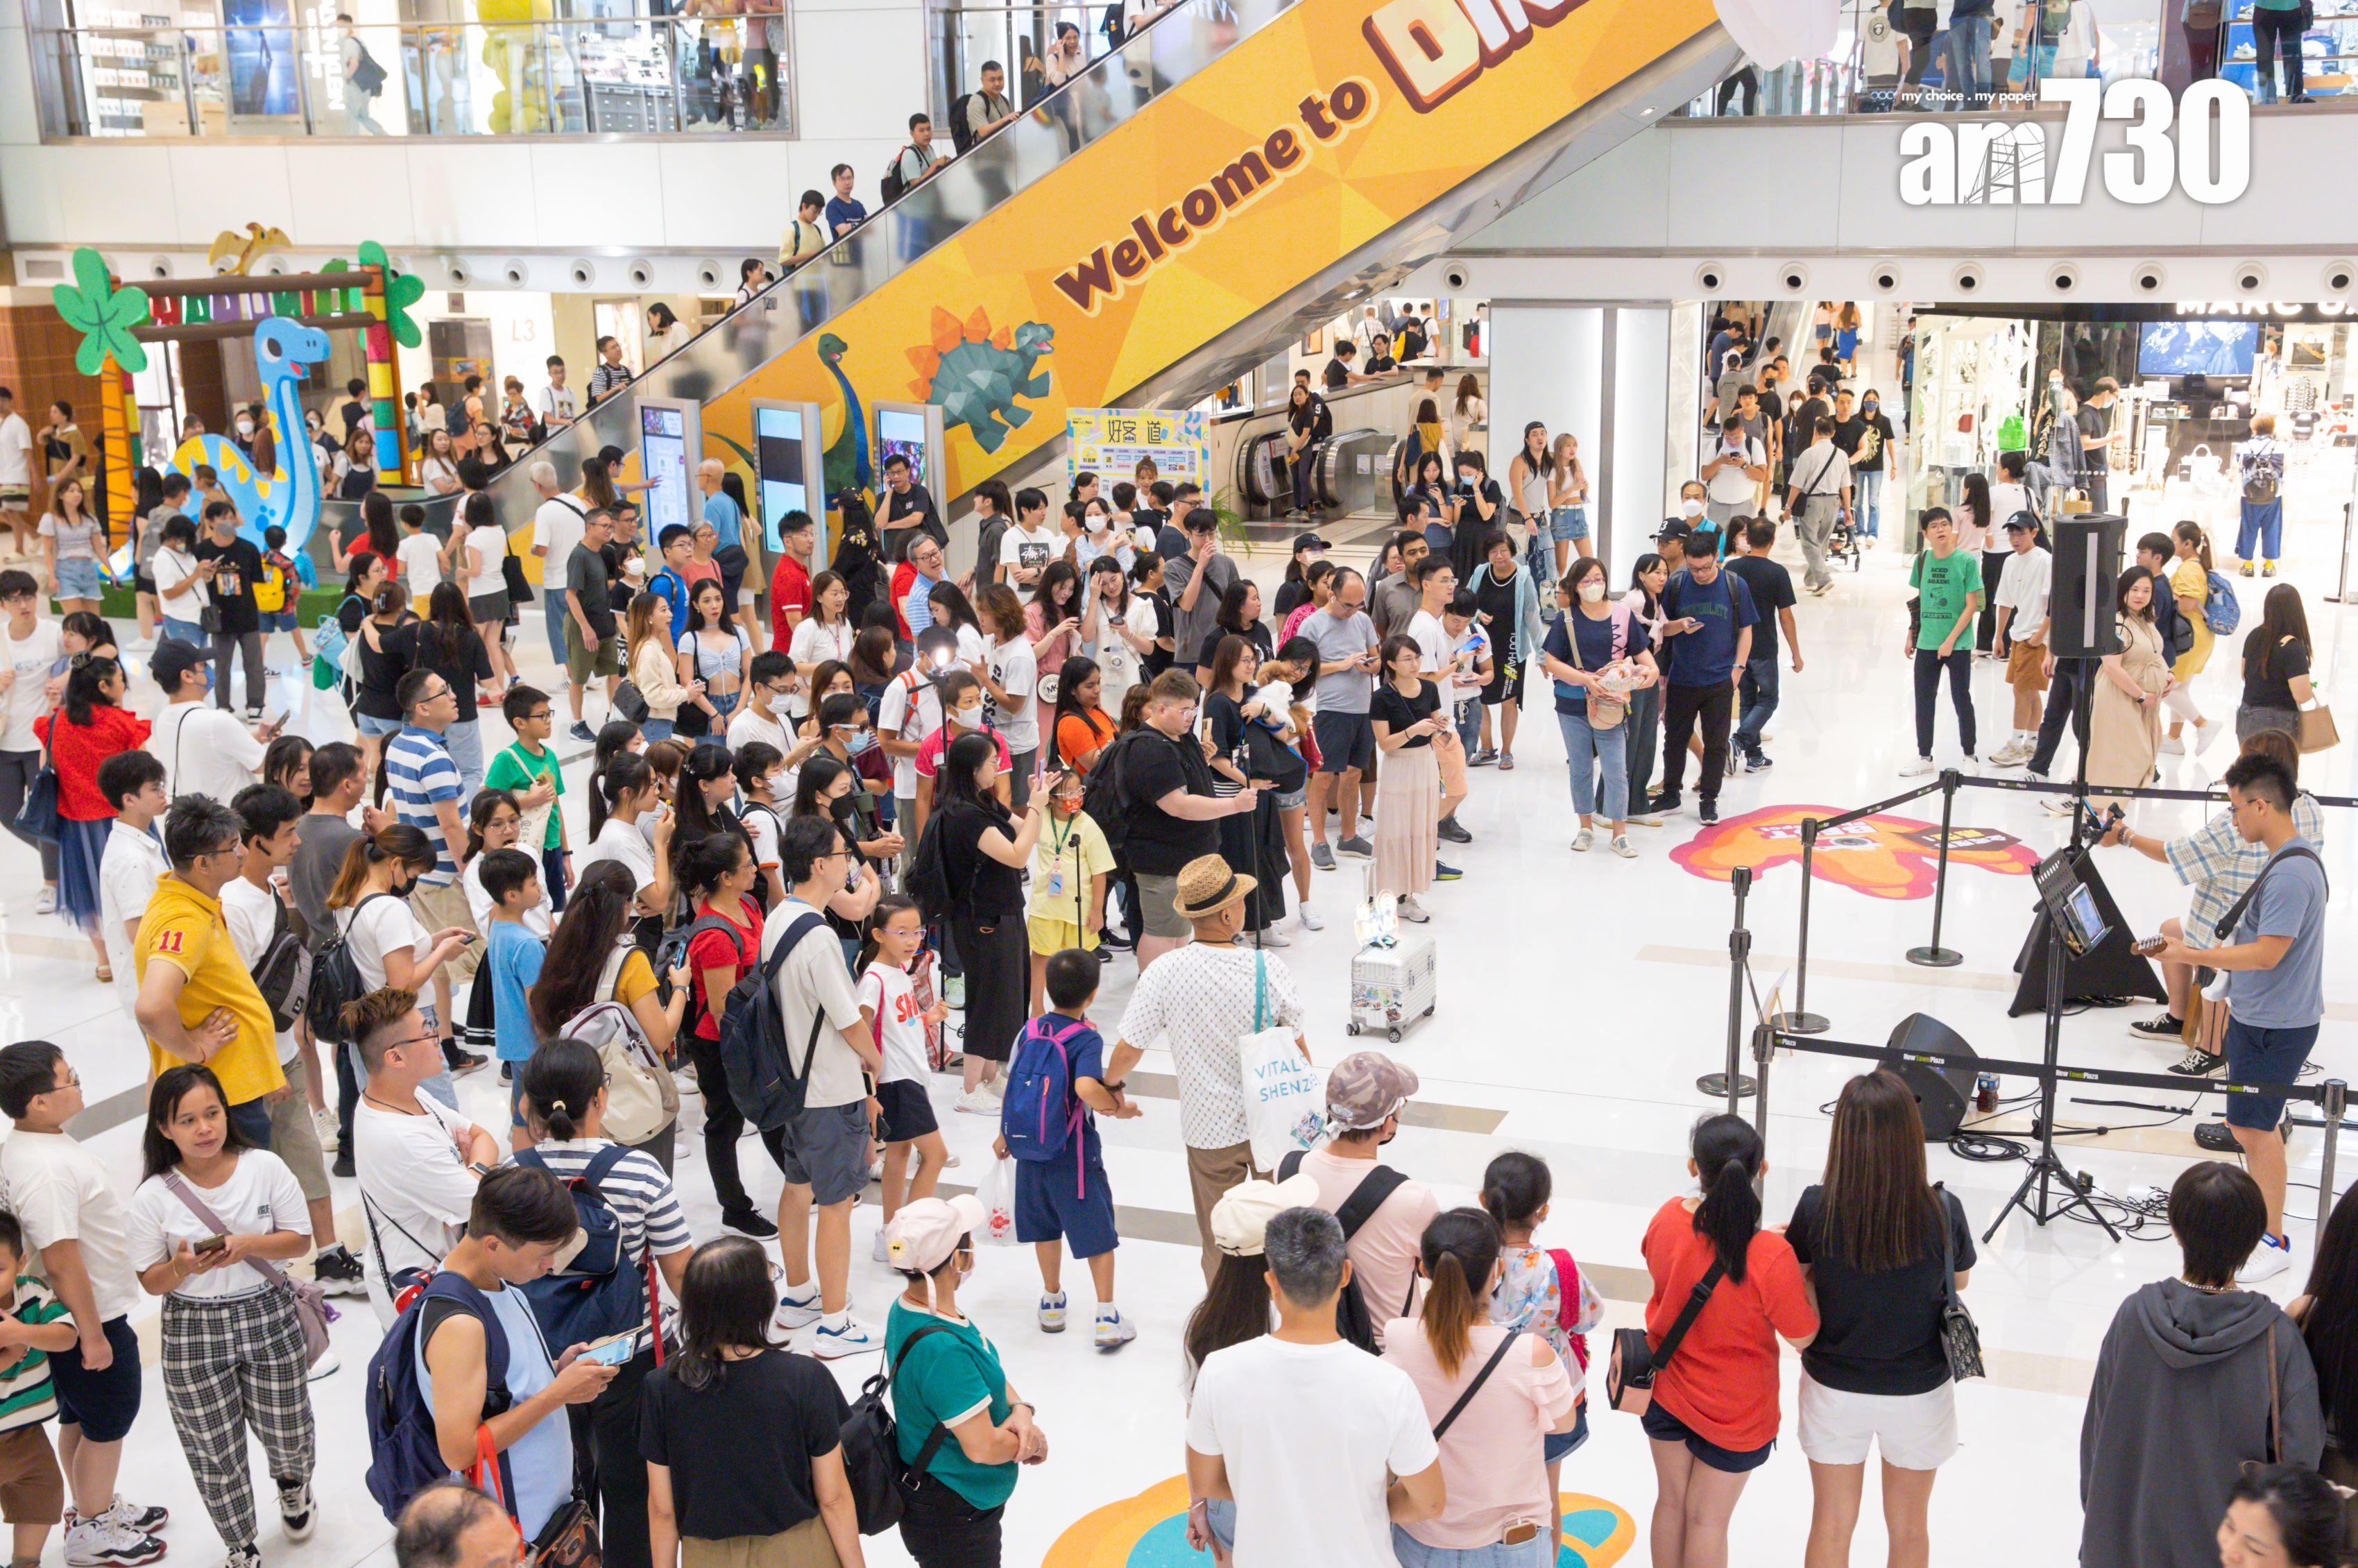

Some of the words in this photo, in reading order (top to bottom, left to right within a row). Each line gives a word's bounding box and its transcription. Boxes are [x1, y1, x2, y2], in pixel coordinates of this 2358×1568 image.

[1052, 127, 1306, 314] Welcome
[1296, 78, 1374, 143] to
[512, 318, 534, 341] L3
[1315, 403, 1322, 414] 9
[1660, 520, 1668, 531] 3
[982, 664, 1002, 716] GUSS
[158, 930, 185, 953] 11
[1782, 1038, 1796, 1046] Plaza
[1930, 1056, 1945, 1064] Plaza
[2243, 1085, 2259, 1093] Plaza
